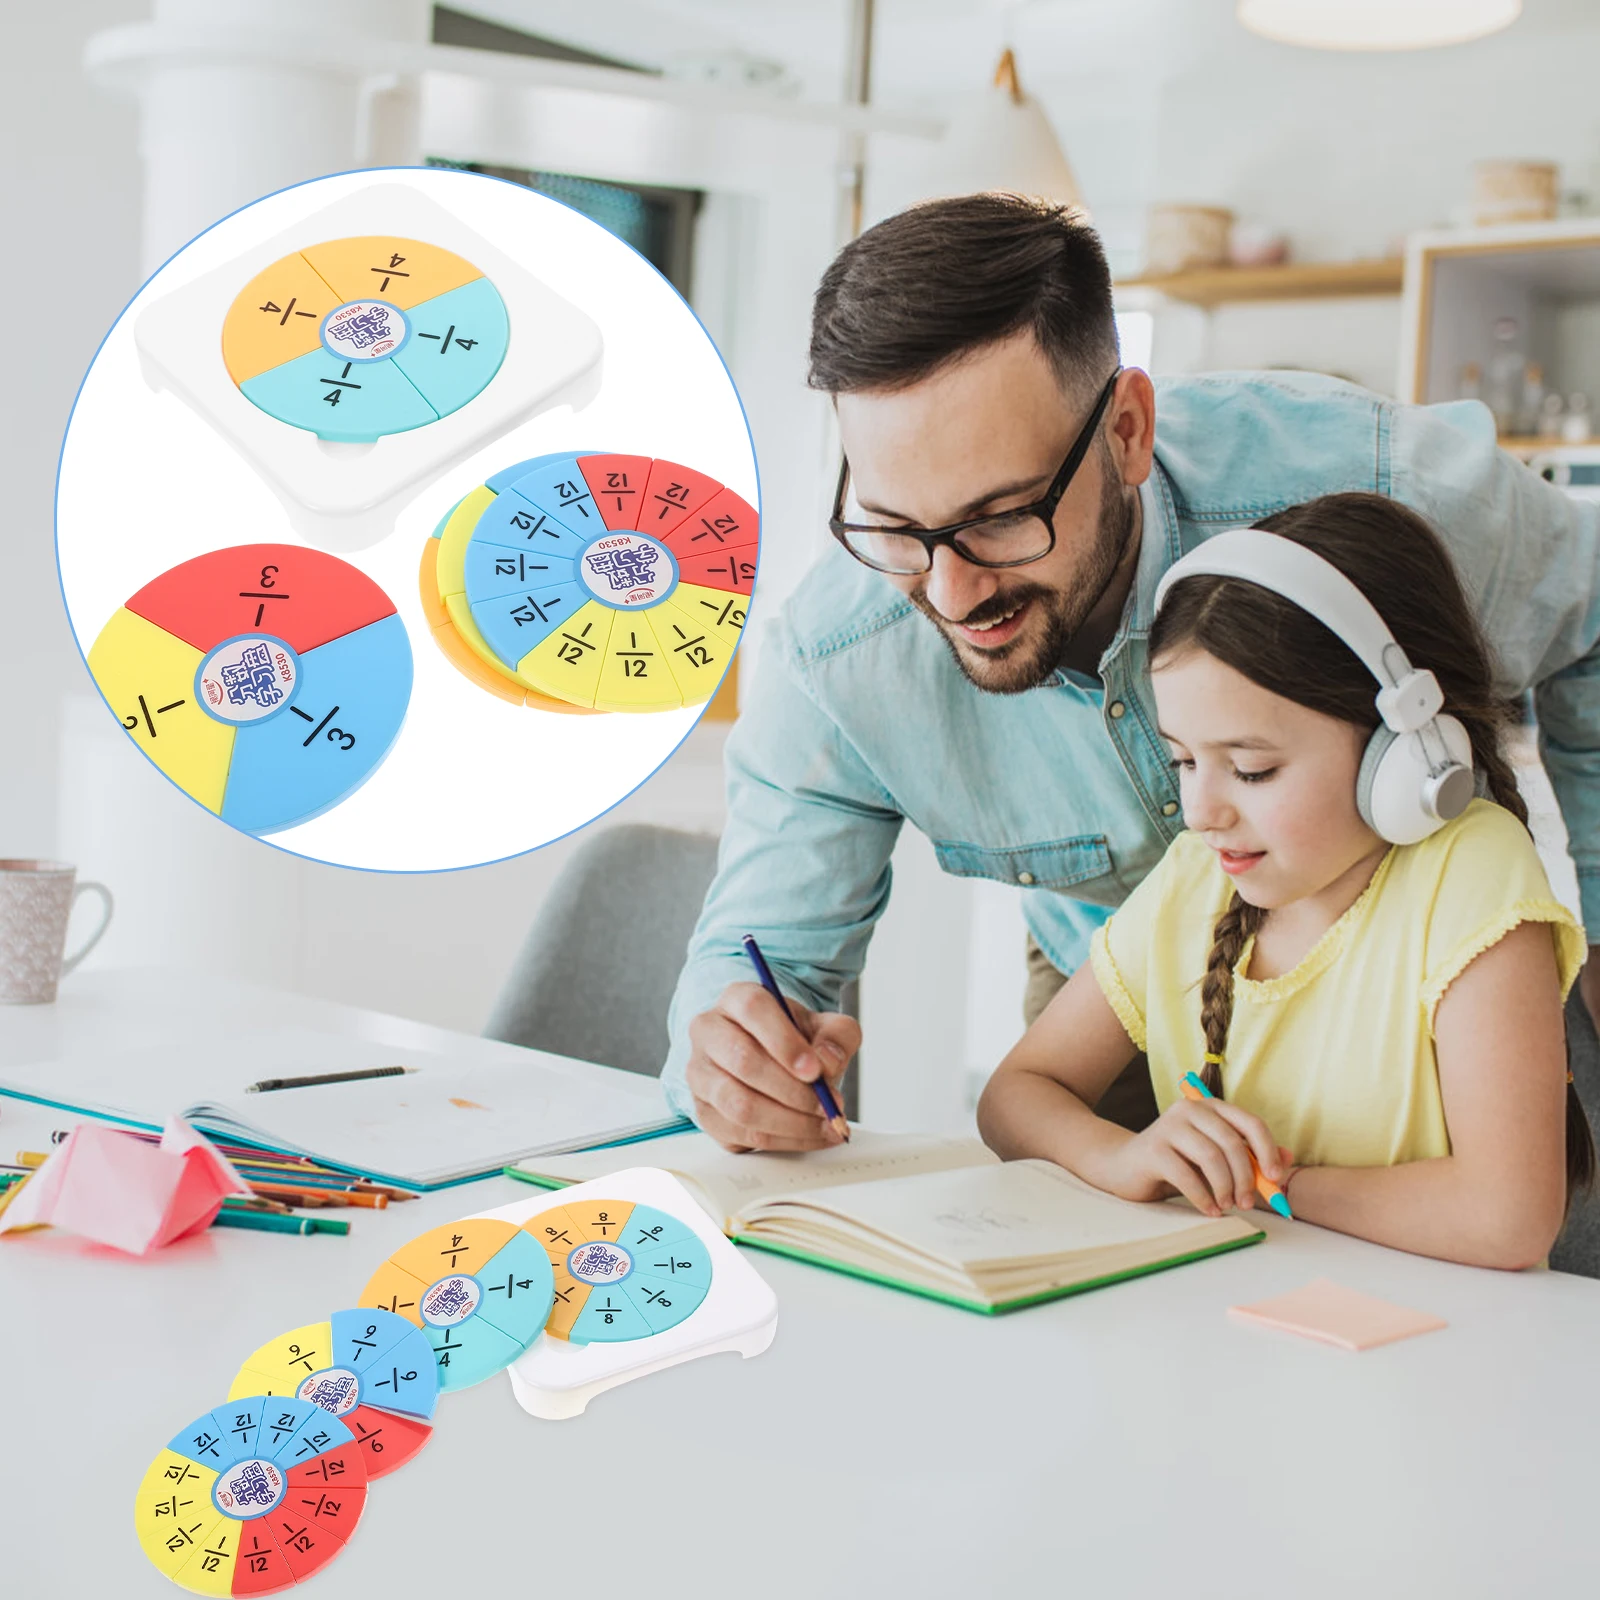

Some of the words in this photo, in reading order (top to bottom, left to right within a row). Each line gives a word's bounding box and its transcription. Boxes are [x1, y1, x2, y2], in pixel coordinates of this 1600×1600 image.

[598, 536, 632, 550] K8530
[221, 662, 255, 705] 分数
[241, 643, 284, 708] 学习盘
[275, 652, 293, 683] K8530
